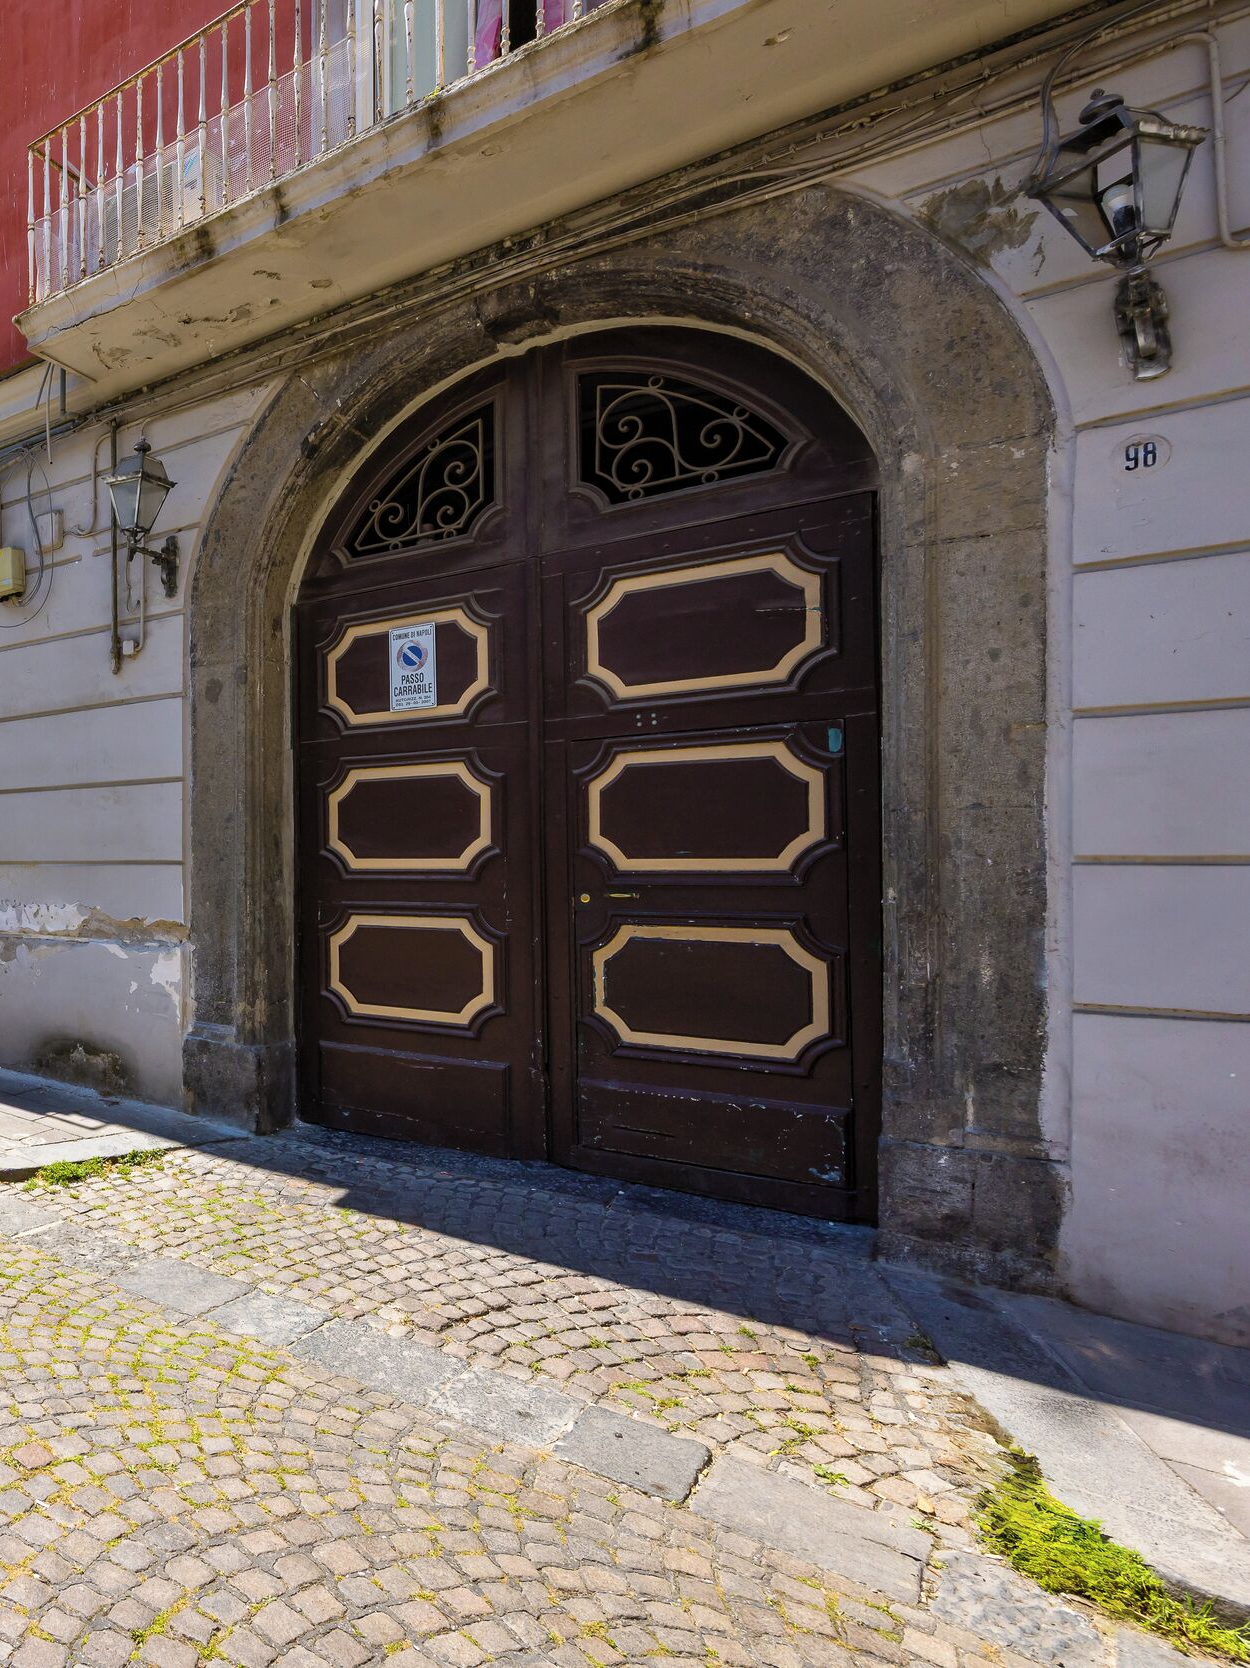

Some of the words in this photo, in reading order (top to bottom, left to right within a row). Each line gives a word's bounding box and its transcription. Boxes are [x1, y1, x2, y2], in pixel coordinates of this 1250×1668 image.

[1125, 441, 1157, 471] 98
[392, 632, 410, 641] COMUNE
[416, 628, 432, 637] NAPOLI
[401, 673, 425, 685] PASSO
[393, 683, 433, 697] CARRABILE
